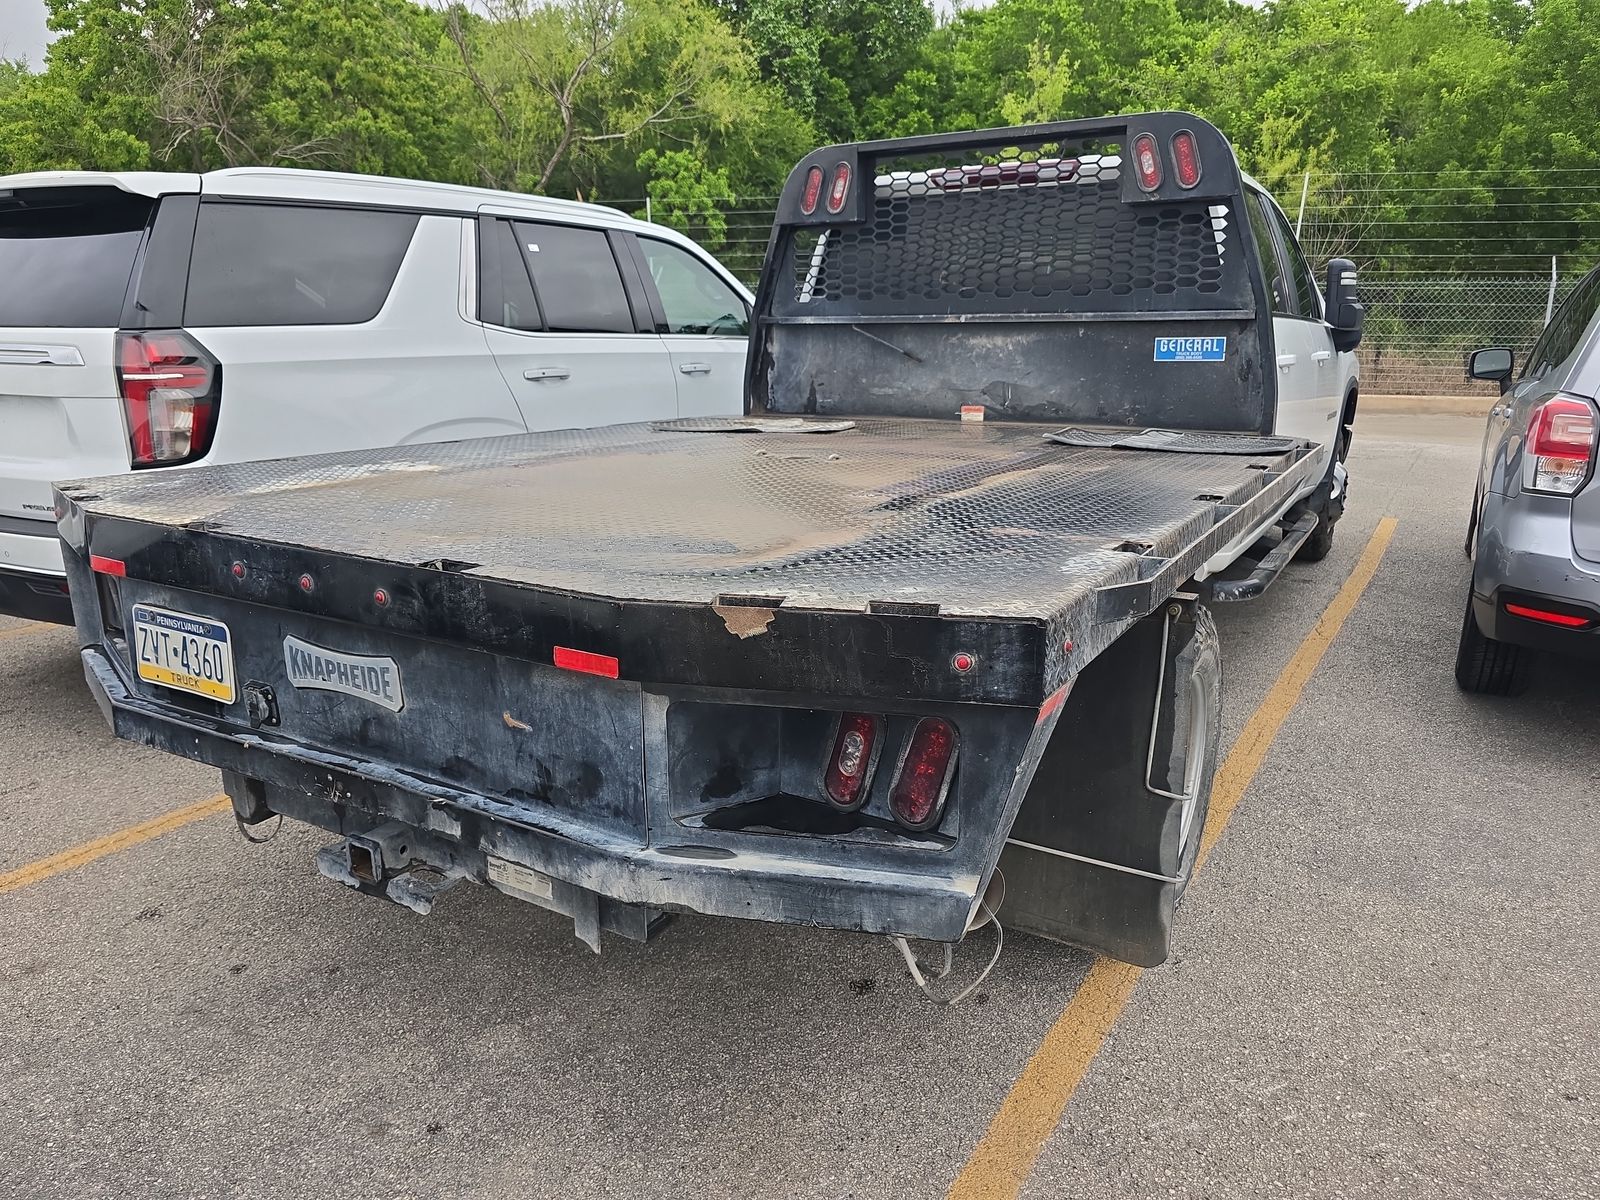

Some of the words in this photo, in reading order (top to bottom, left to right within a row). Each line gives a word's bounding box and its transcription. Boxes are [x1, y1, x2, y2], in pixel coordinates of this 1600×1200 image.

[1160, 339, 1220, 352] GENERAL
[156, 615, 205, 635] PENNSYLVANIA
[170, 672, 200, 689] TRUCK
[288, 645, 395, 703] KNAPHEIDE
